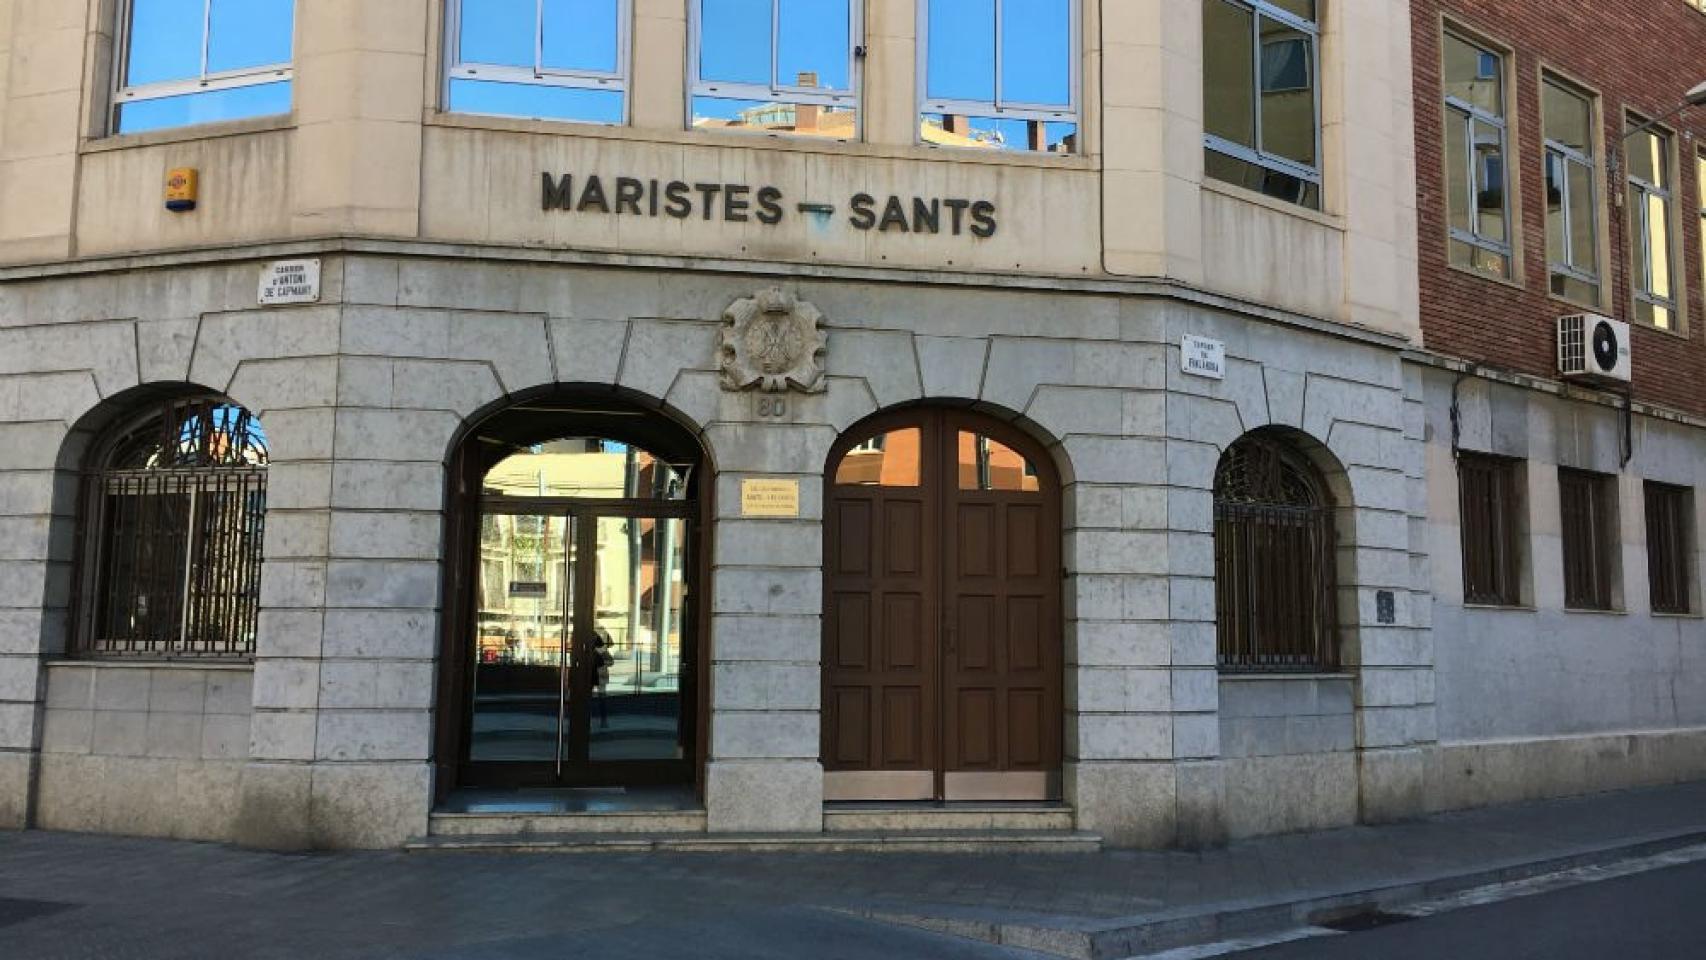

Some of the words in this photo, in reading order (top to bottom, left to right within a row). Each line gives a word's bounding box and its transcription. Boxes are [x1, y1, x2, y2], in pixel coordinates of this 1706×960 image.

[541, 171, 783, 225] MARISTES
[849, 193, 997, 238] SANTS
[758, 398, 786, 417] 80
